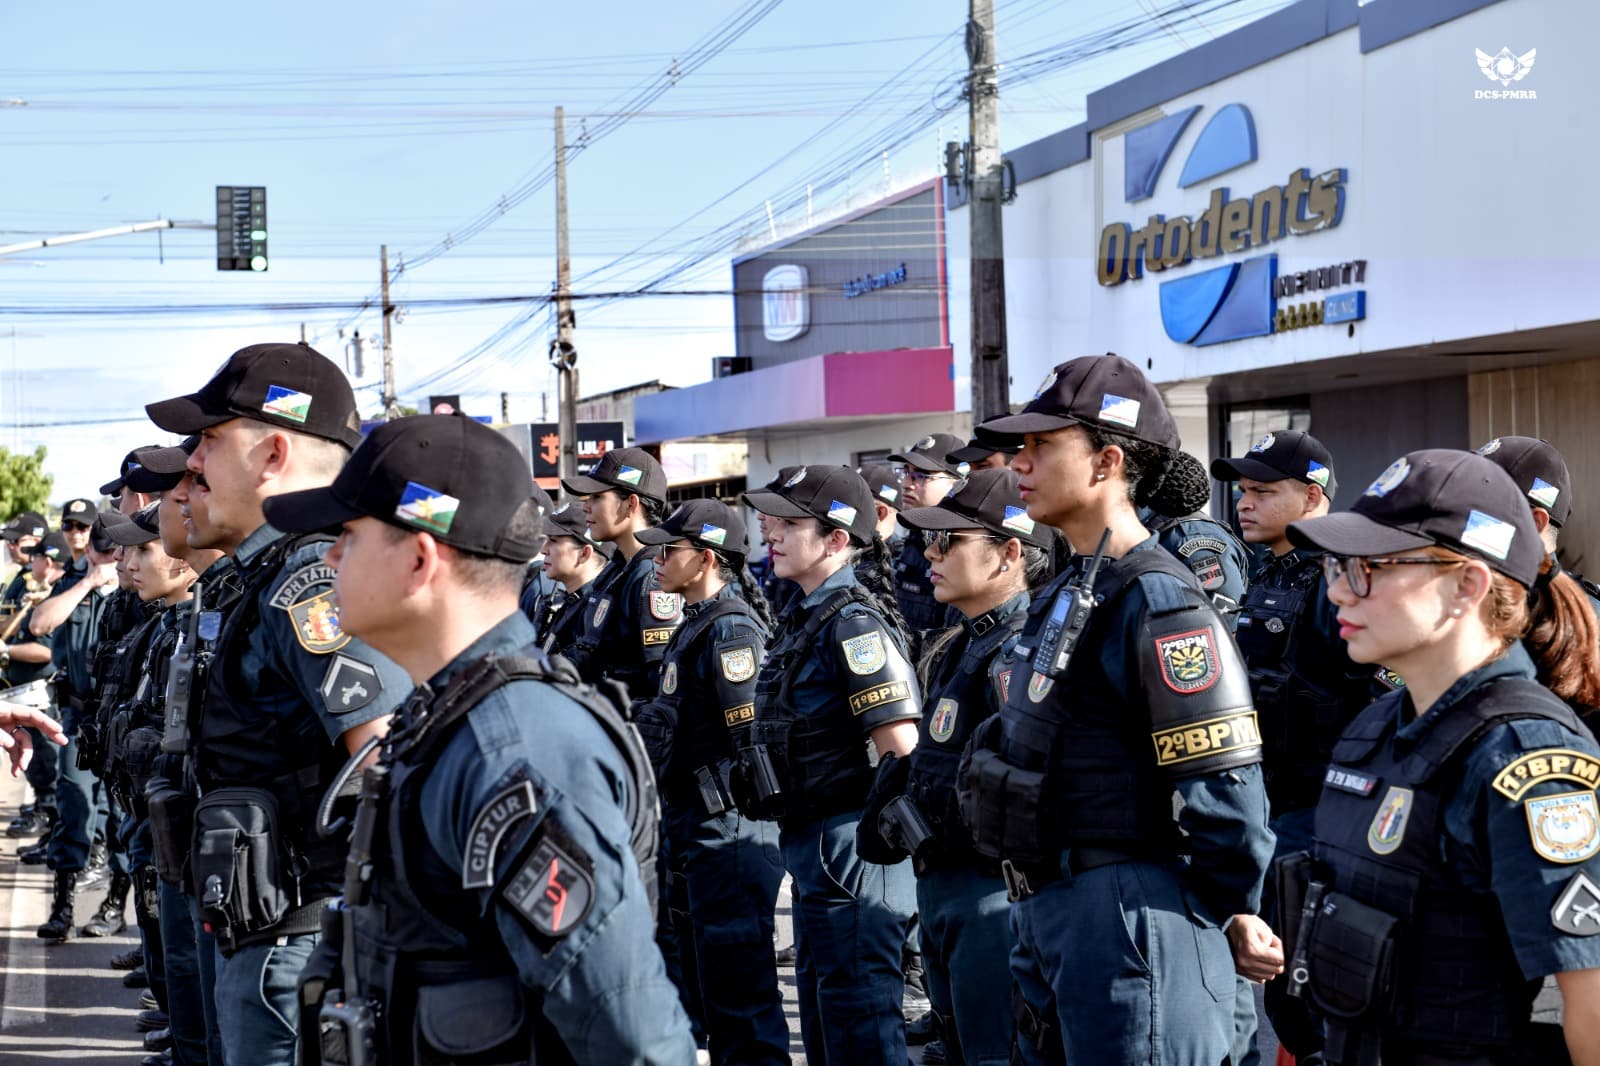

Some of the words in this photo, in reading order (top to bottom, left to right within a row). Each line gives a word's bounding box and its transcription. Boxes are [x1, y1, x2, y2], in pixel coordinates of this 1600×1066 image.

[1097, 167, 1349, 287] Ortodents
[1273, 260, 1367, 299] INFINITY
[279, 580, 302, 605] APH
[646, 630, 673, 641] 2ºB
[1162, 634, 1210, 657] 2ºBPM
[853, 685, 906, 709] 1ºBPM
[727, 705, 755, 722] 1ºB
[1158, 715, 1257, 760] 2ºBPM
[1503, 755, 1599, 792] 1ºBPM
[471, 795, 522, 872] CIPTUR
